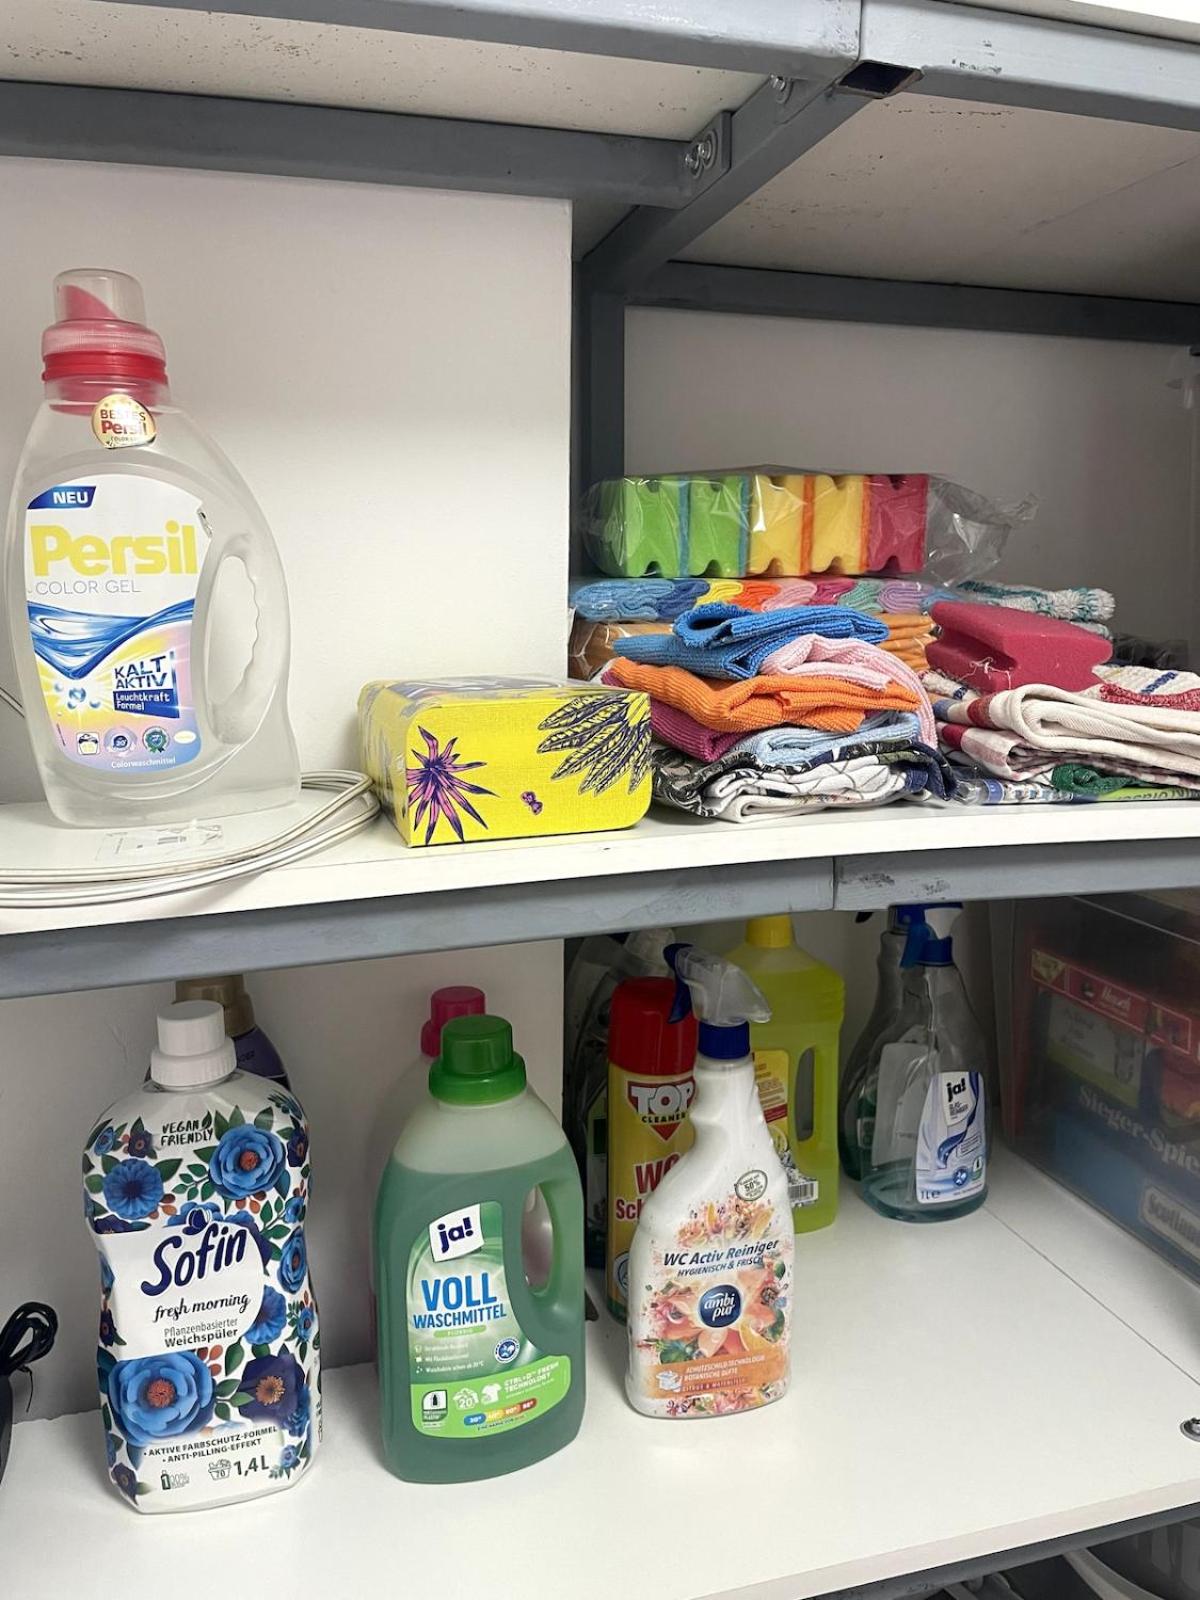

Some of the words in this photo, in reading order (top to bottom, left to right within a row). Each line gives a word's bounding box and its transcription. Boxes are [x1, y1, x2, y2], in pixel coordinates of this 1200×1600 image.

[100, 408, 146, 422] BEES
[101, 420, 147, 435] Persl
[53, 491, 88, 504] NEU
[30, 520, 198, 577] Persil
[35, 581, 98, 595] COLOR
[105, 580, 141, 594] GEL
[114, 656, 167, 680] KALT
[115, 673, 168, 689] AKTIV
[115, 692, 170, 703] Leuchtkraft
[116, 701, 145, 711] Formel
[111, 756, 176, 769] Colorwaschmittel
[631, 1081, 694, 1115] TOP
[946, 1077, 967, 1102] ja!
[162, 1120, 199, 1134] VEGAN
[641, 1112, 686, 1124] CLEANER
[161, 1128, 214, 1147] FRIENDLY
[436, 1216, 474, 1253] ja!
[141, 1222, 248, 1297] Sofin
[663, 1252, 688, 1267] WC
[690, 1248, 724, 1266] Activ
[726, 1239, 779, 1262] Reiniger
[677, 1261, 727, 1277] HYGIENISCH
[420, 1272, 497, 1312] VOLL
[152, 1298, 191, 1323] fresh
[192, 1293, 251, 1313] morning
[704, 1293, 736, 1313] ambi
[712, 1304, 736, 1322] pur
[413, 1303, 507, 1330] WASCHMITTEL
[164, 1318, 239, 1338] Pflanzenbasierter
[164, 1328, 239, 1348] Weichspüler
[458, 1398, 473, 1409] 20
[148, 1444, 181, 1457] AKTIVE
[182, 1426, 278, 1451] FARBSCHUTZ-FORMEL
[168, 1438, 262, 1463] ANTI-PILLING-EFFEKT
